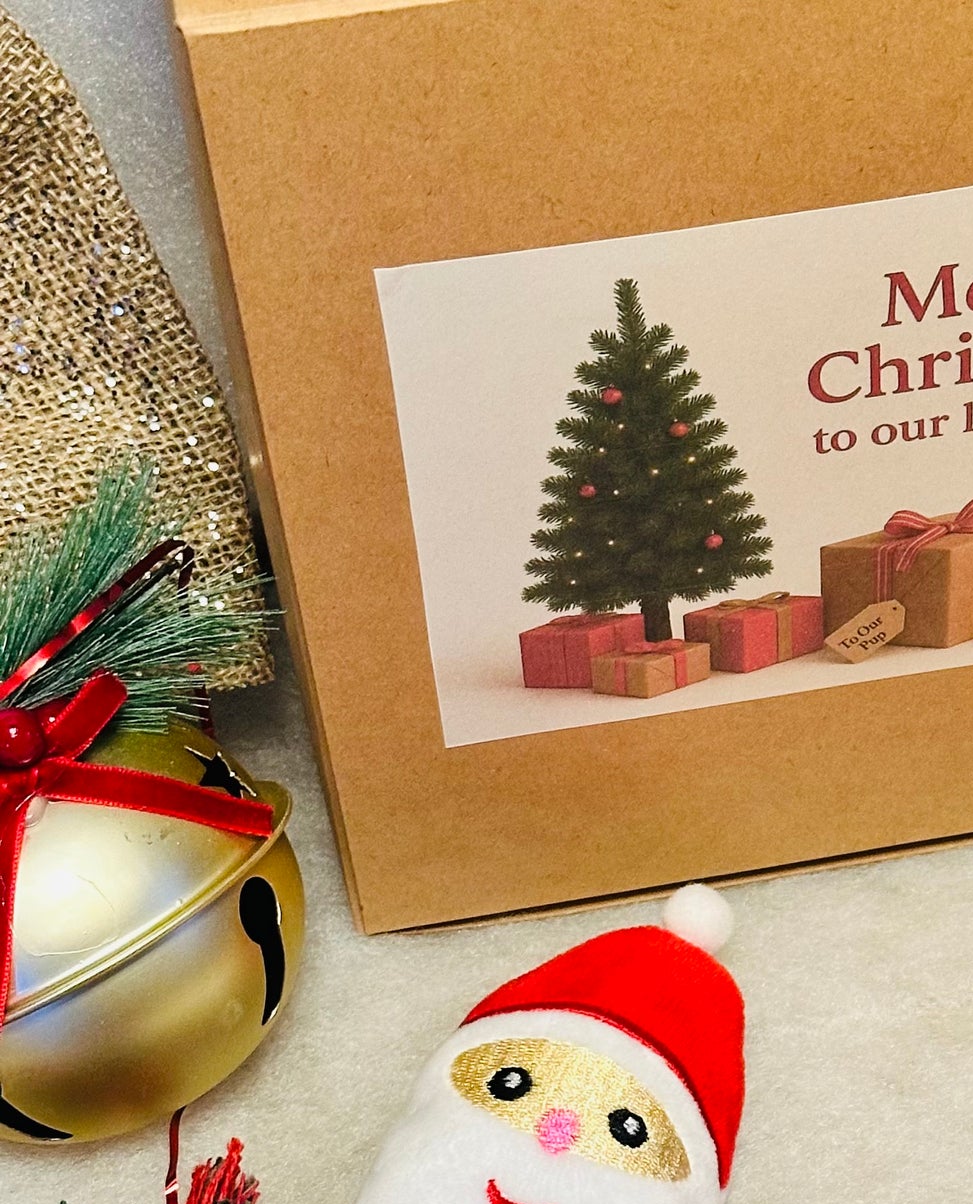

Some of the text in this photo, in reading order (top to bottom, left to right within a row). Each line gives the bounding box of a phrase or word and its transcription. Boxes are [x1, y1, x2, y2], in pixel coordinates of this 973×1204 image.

[812, 426, 858, 454] to
[870, 413, 950, 446] our
[839, 616, 883, 650] To Our
[858, 631, 887, 651] Pup
